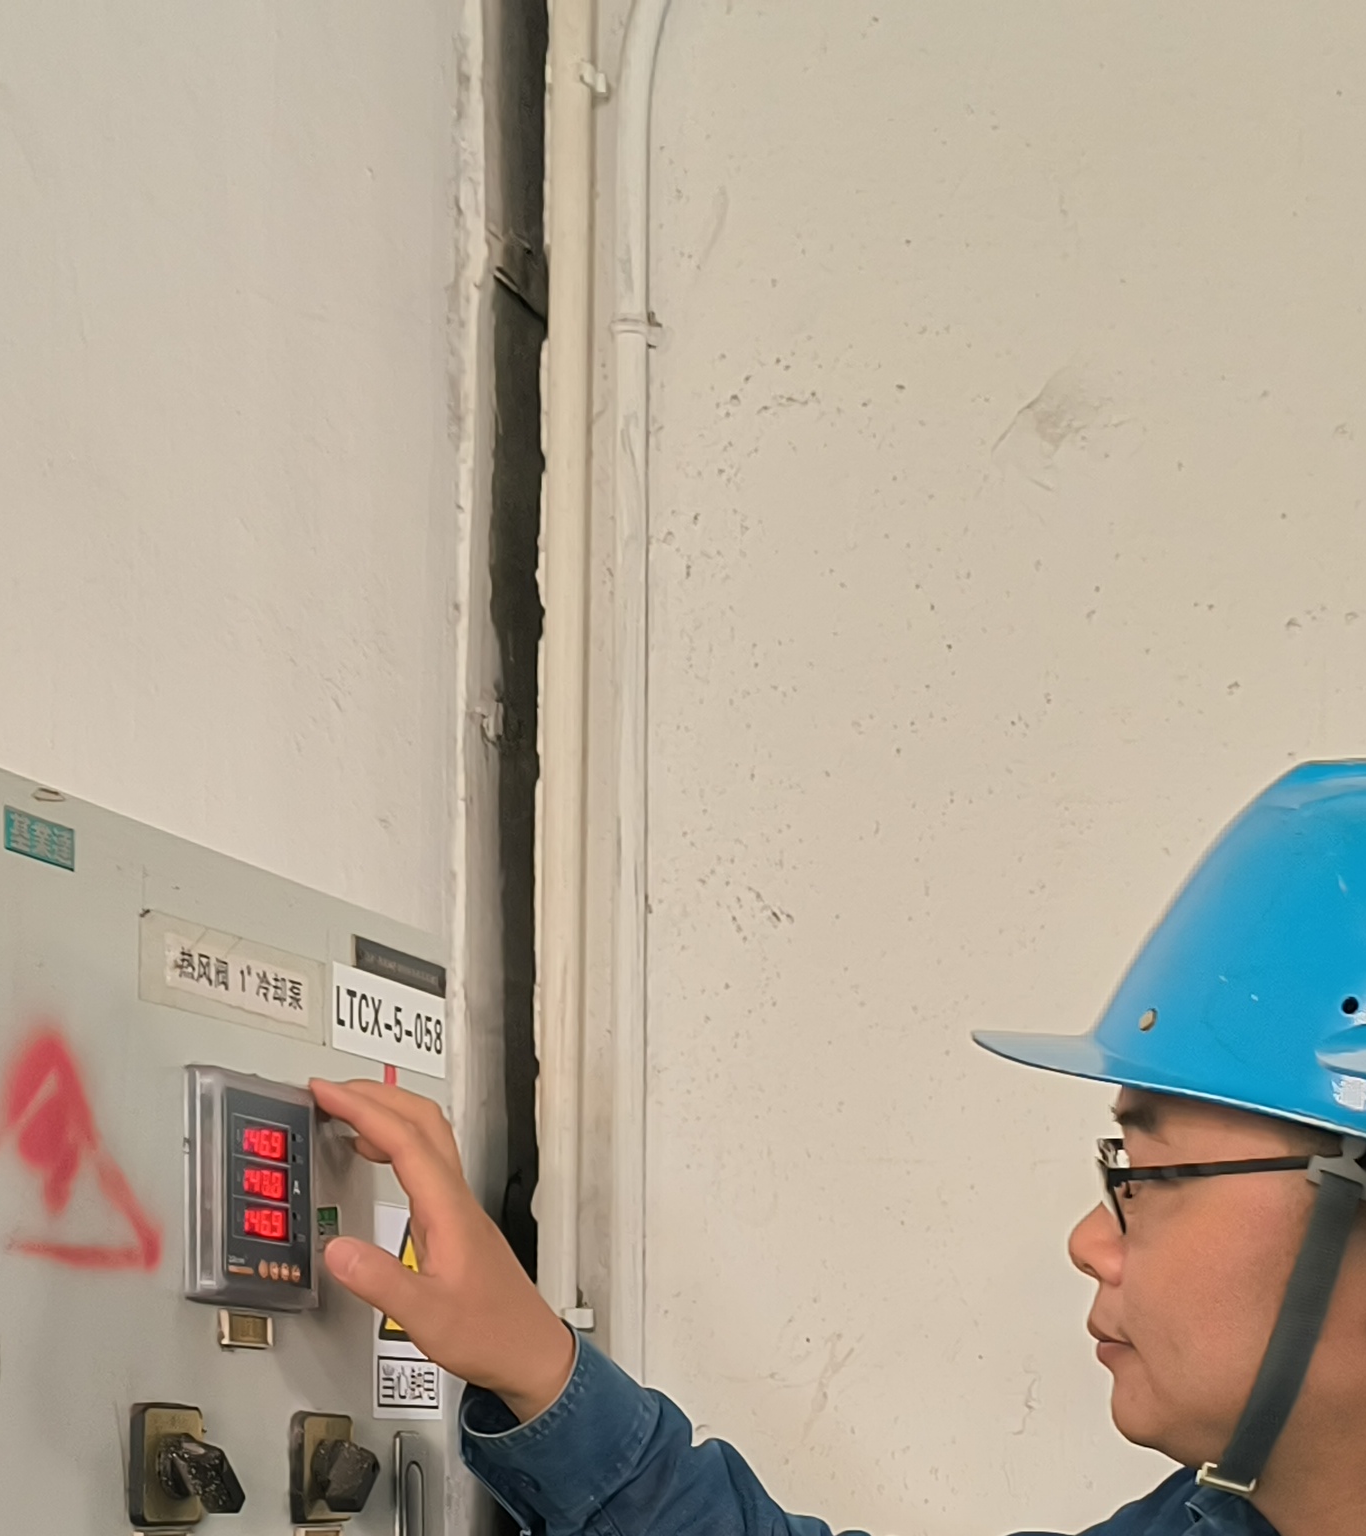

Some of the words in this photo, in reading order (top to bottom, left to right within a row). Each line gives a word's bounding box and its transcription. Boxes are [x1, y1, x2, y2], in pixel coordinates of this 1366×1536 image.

[177, 945, 231, 992] 热风阀
[255, 969, 304, 1011] 冷却泵
[335, 984, 444, 1056] LTCX-5-058
